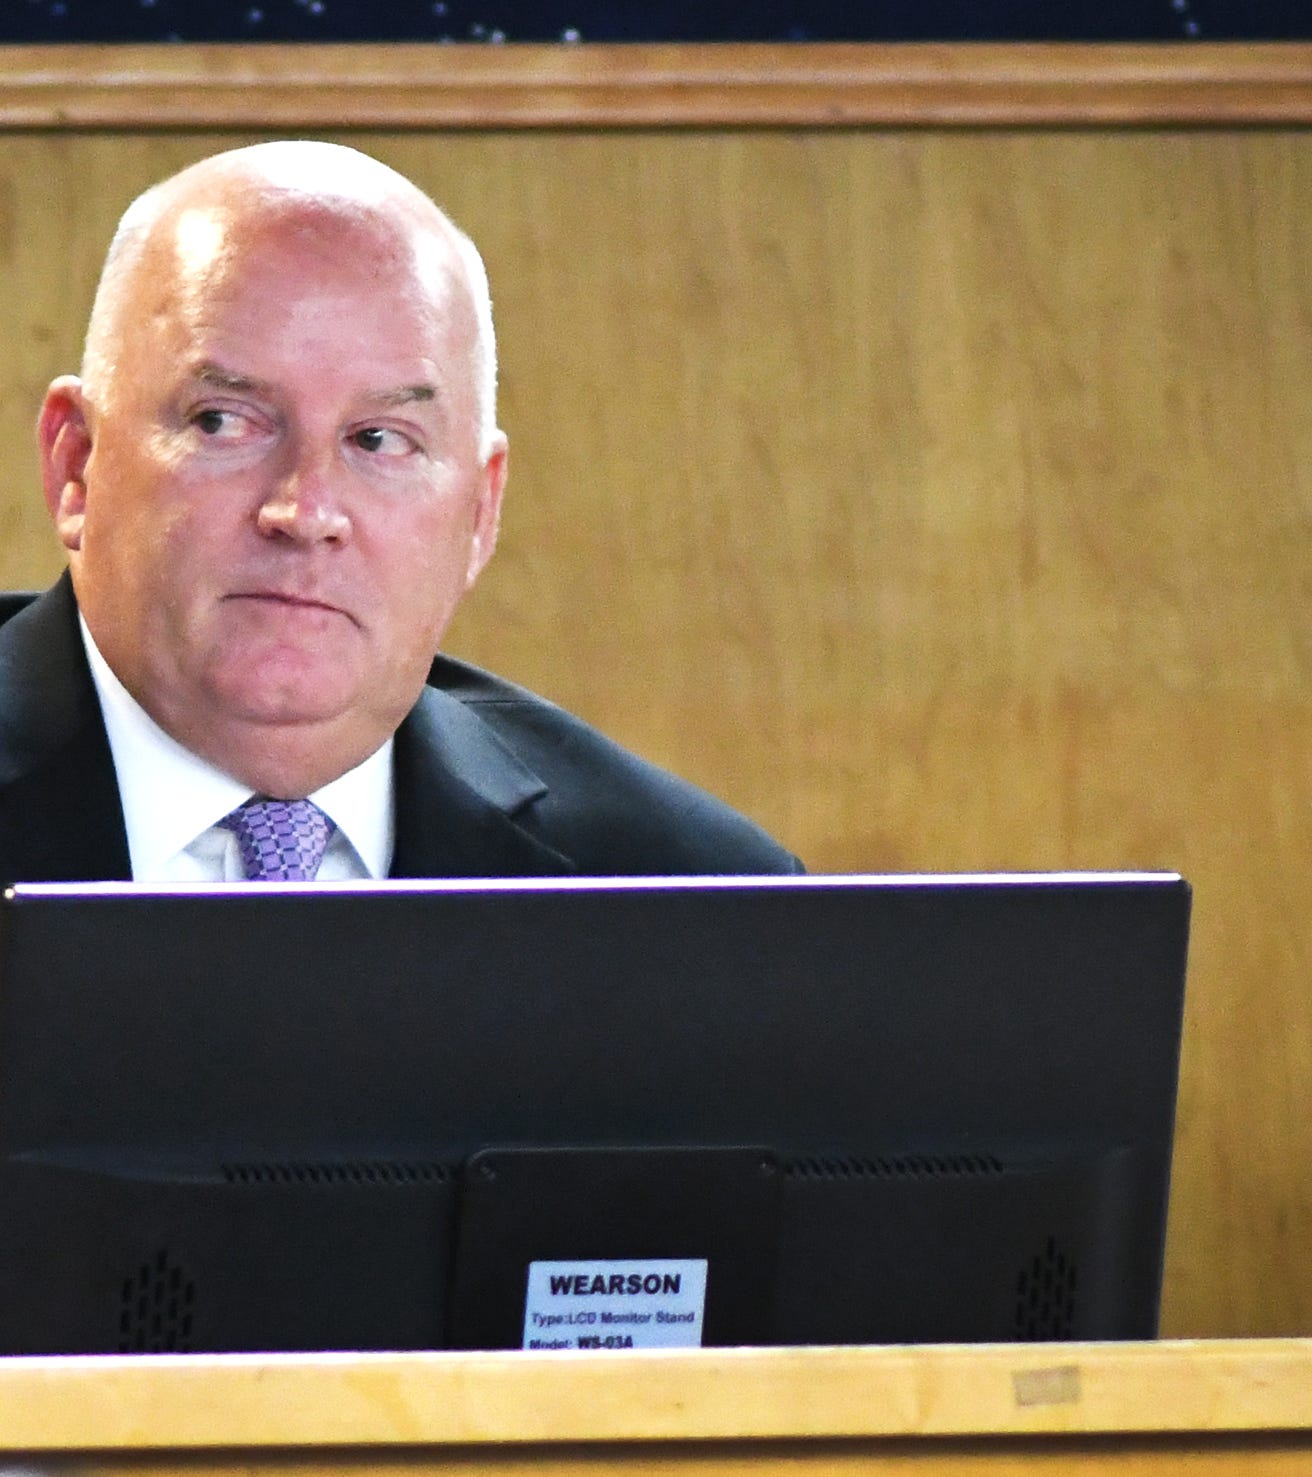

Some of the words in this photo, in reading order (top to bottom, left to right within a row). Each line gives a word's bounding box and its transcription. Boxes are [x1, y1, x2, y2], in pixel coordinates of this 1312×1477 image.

[550, 1274, 681, 1295] WEARSON
[601, 1312, 651, 1323] Monitor
[655, 1311, 695, 1324] Stand
